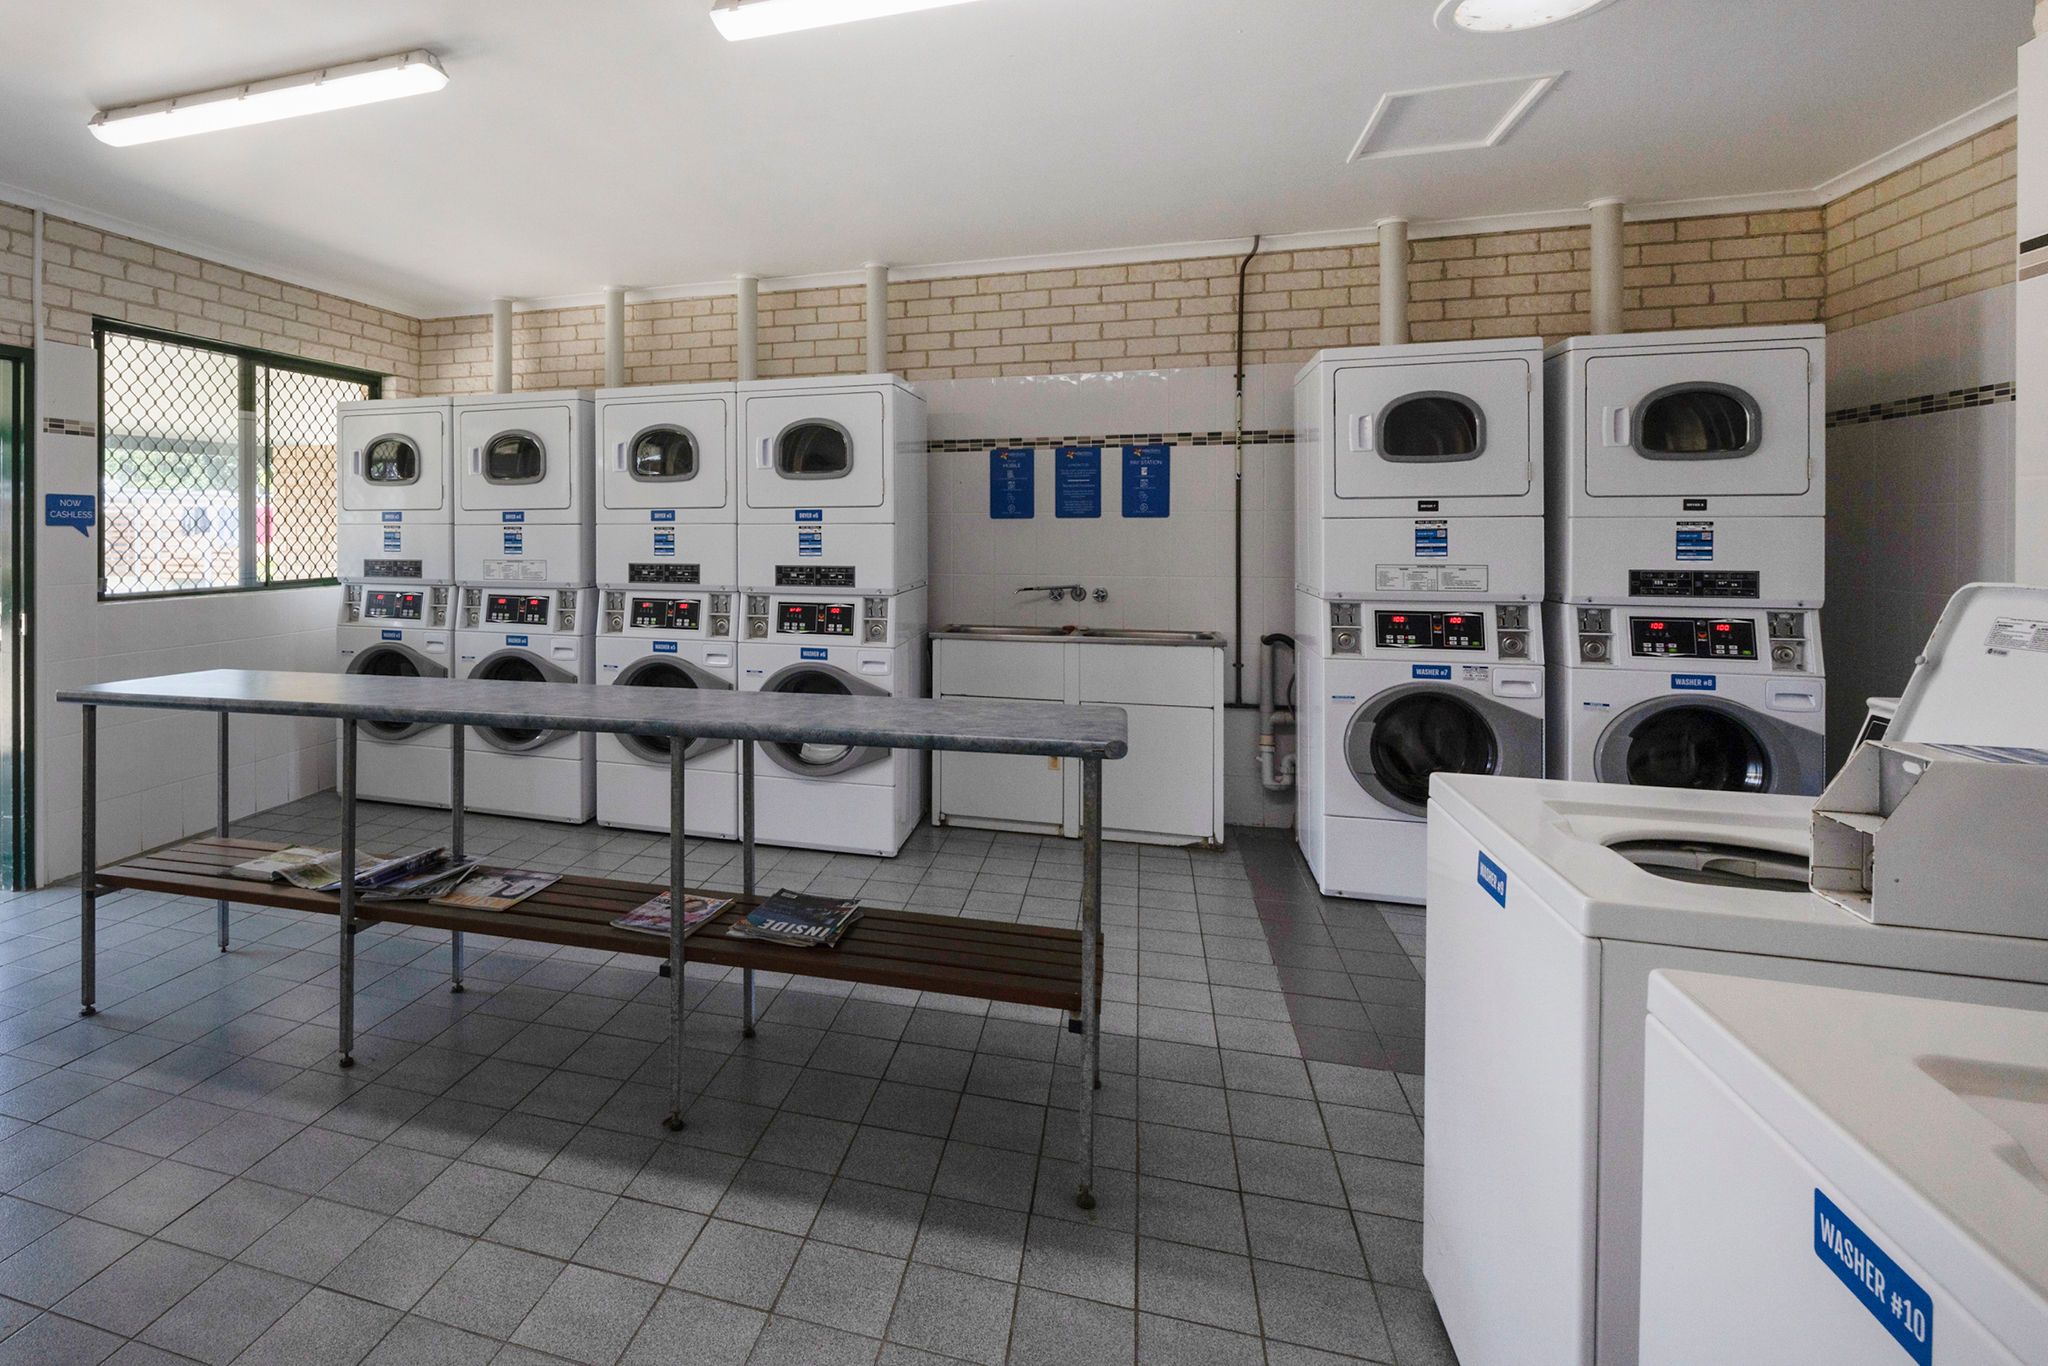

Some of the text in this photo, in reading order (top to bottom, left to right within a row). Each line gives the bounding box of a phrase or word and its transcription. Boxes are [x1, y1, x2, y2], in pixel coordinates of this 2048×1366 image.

[59, 499, 82, 507] NOW
[50, 510, 93, 519] CASHLESS
[1650, 622, 1664, 630] 100
[1415, 668, 1440, 676] WASHER
[1675, 678, 1713, 687] WASHER #8
[757, 919, 830, 938] INSIDE
[1820, 1212, 1926, 1343] WASHER #10
